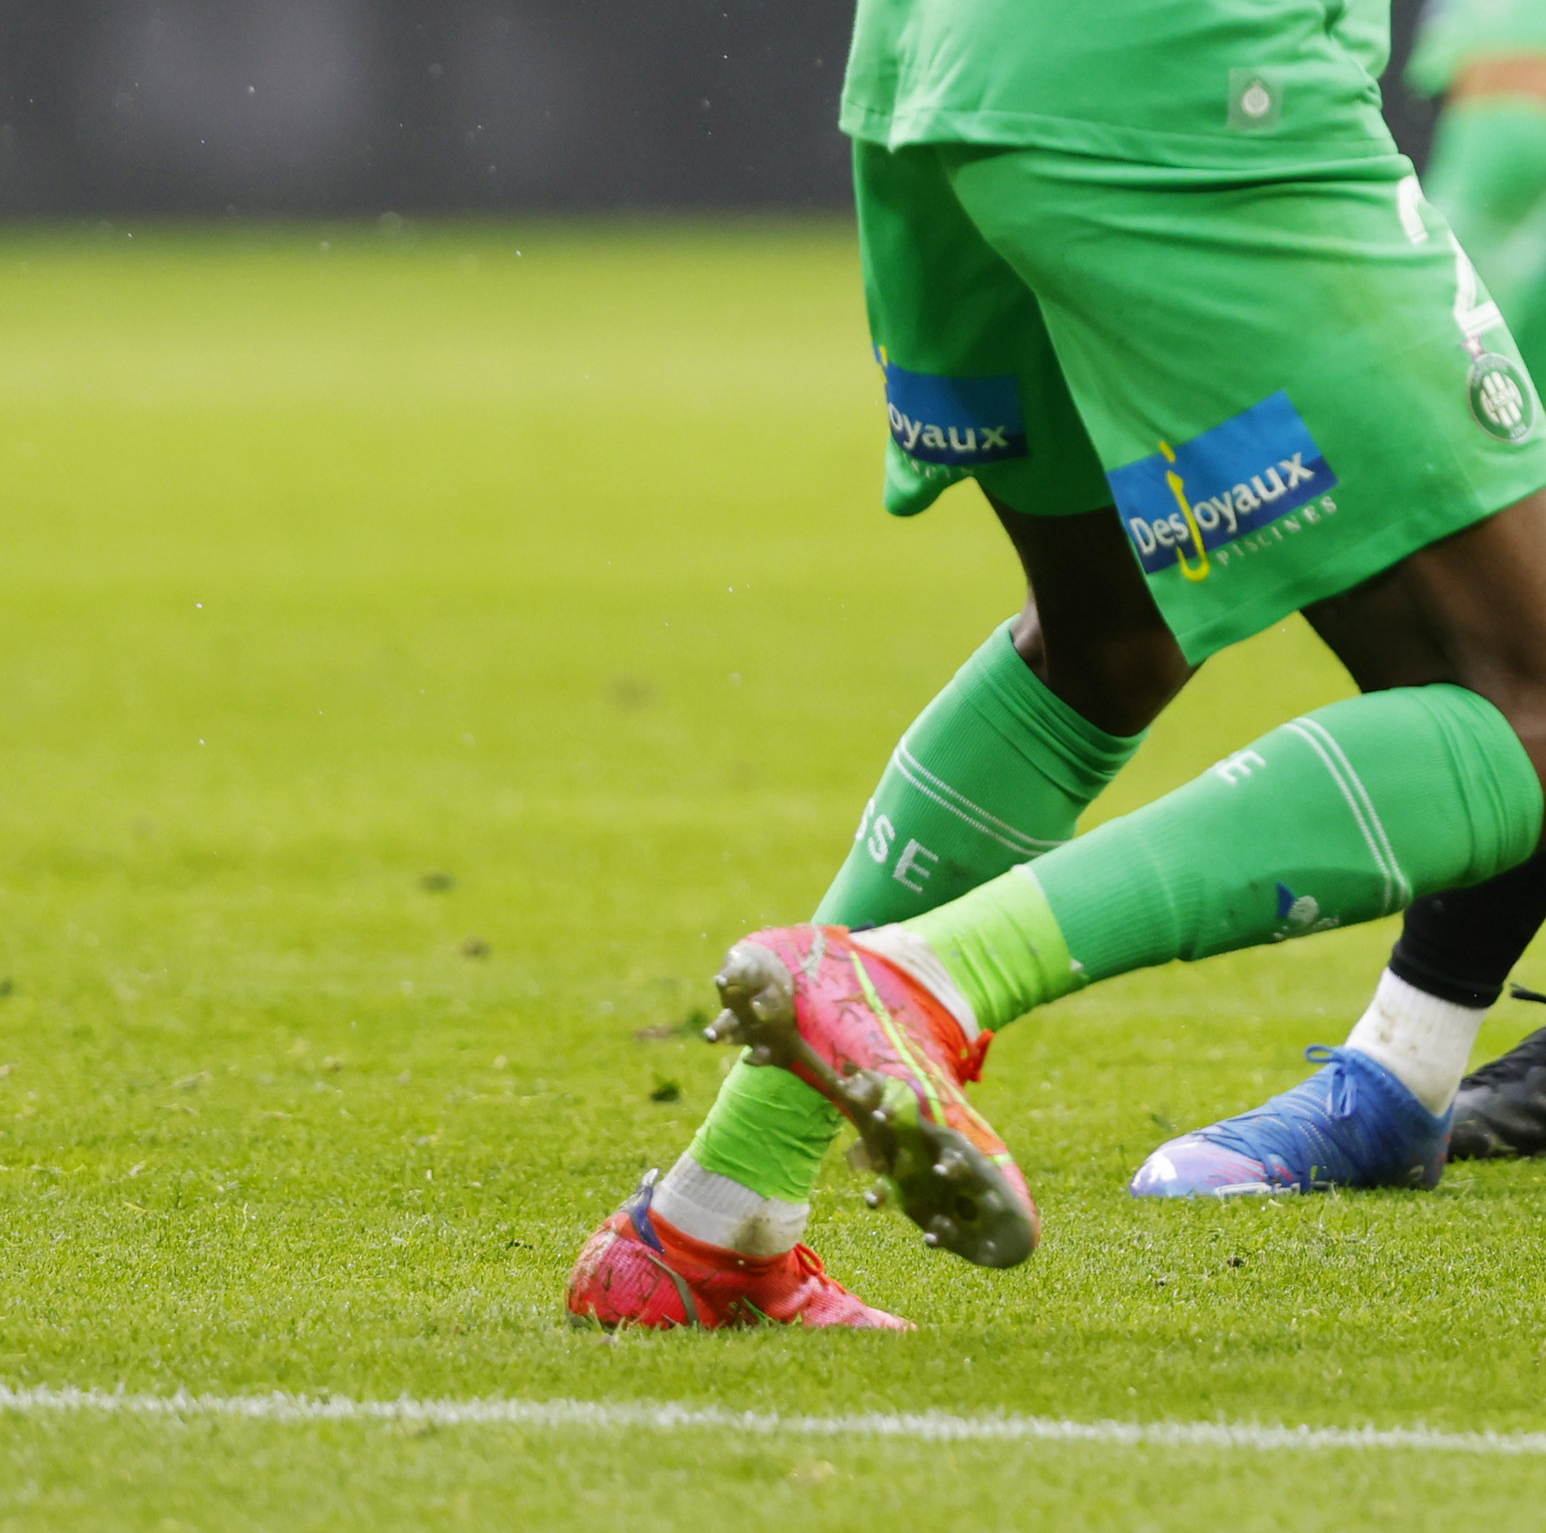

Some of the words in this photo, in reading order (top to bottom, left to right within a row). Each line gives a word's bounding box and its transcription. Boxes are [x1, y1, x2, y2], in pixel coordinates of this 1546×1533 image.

[887, 402, 1008, 453] oyaux
[1129, 439, 1315, 582] Desjoyaux
[1216, 495, 1338, 567] PISCINES
